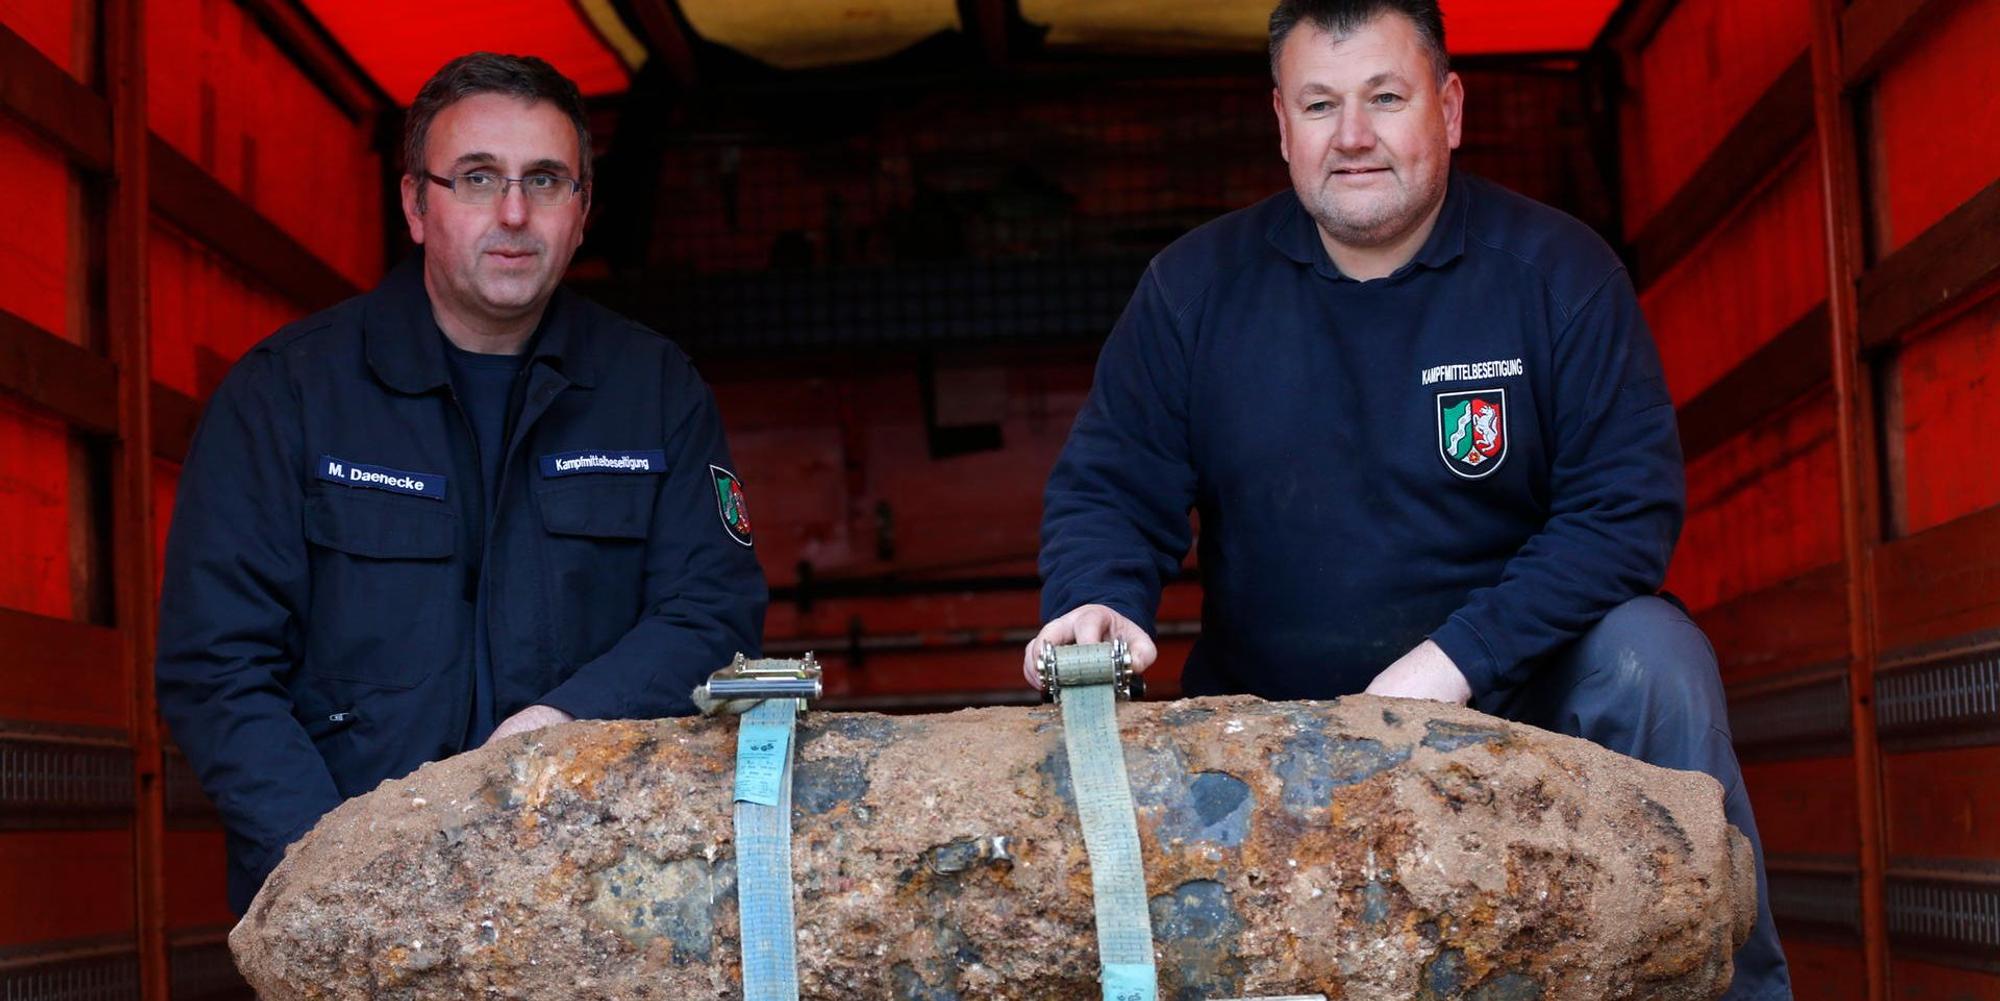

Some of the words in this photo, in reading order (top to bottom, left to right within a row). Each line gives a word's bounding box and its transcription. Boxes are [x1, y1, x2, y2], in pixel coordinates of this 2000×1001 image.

[1421, 358, 1523, 385] KAMPFMITTELBESEITIGUNG
[328, 462, 345, 478] M.
[350, 468, 424, 490] Daenecke
